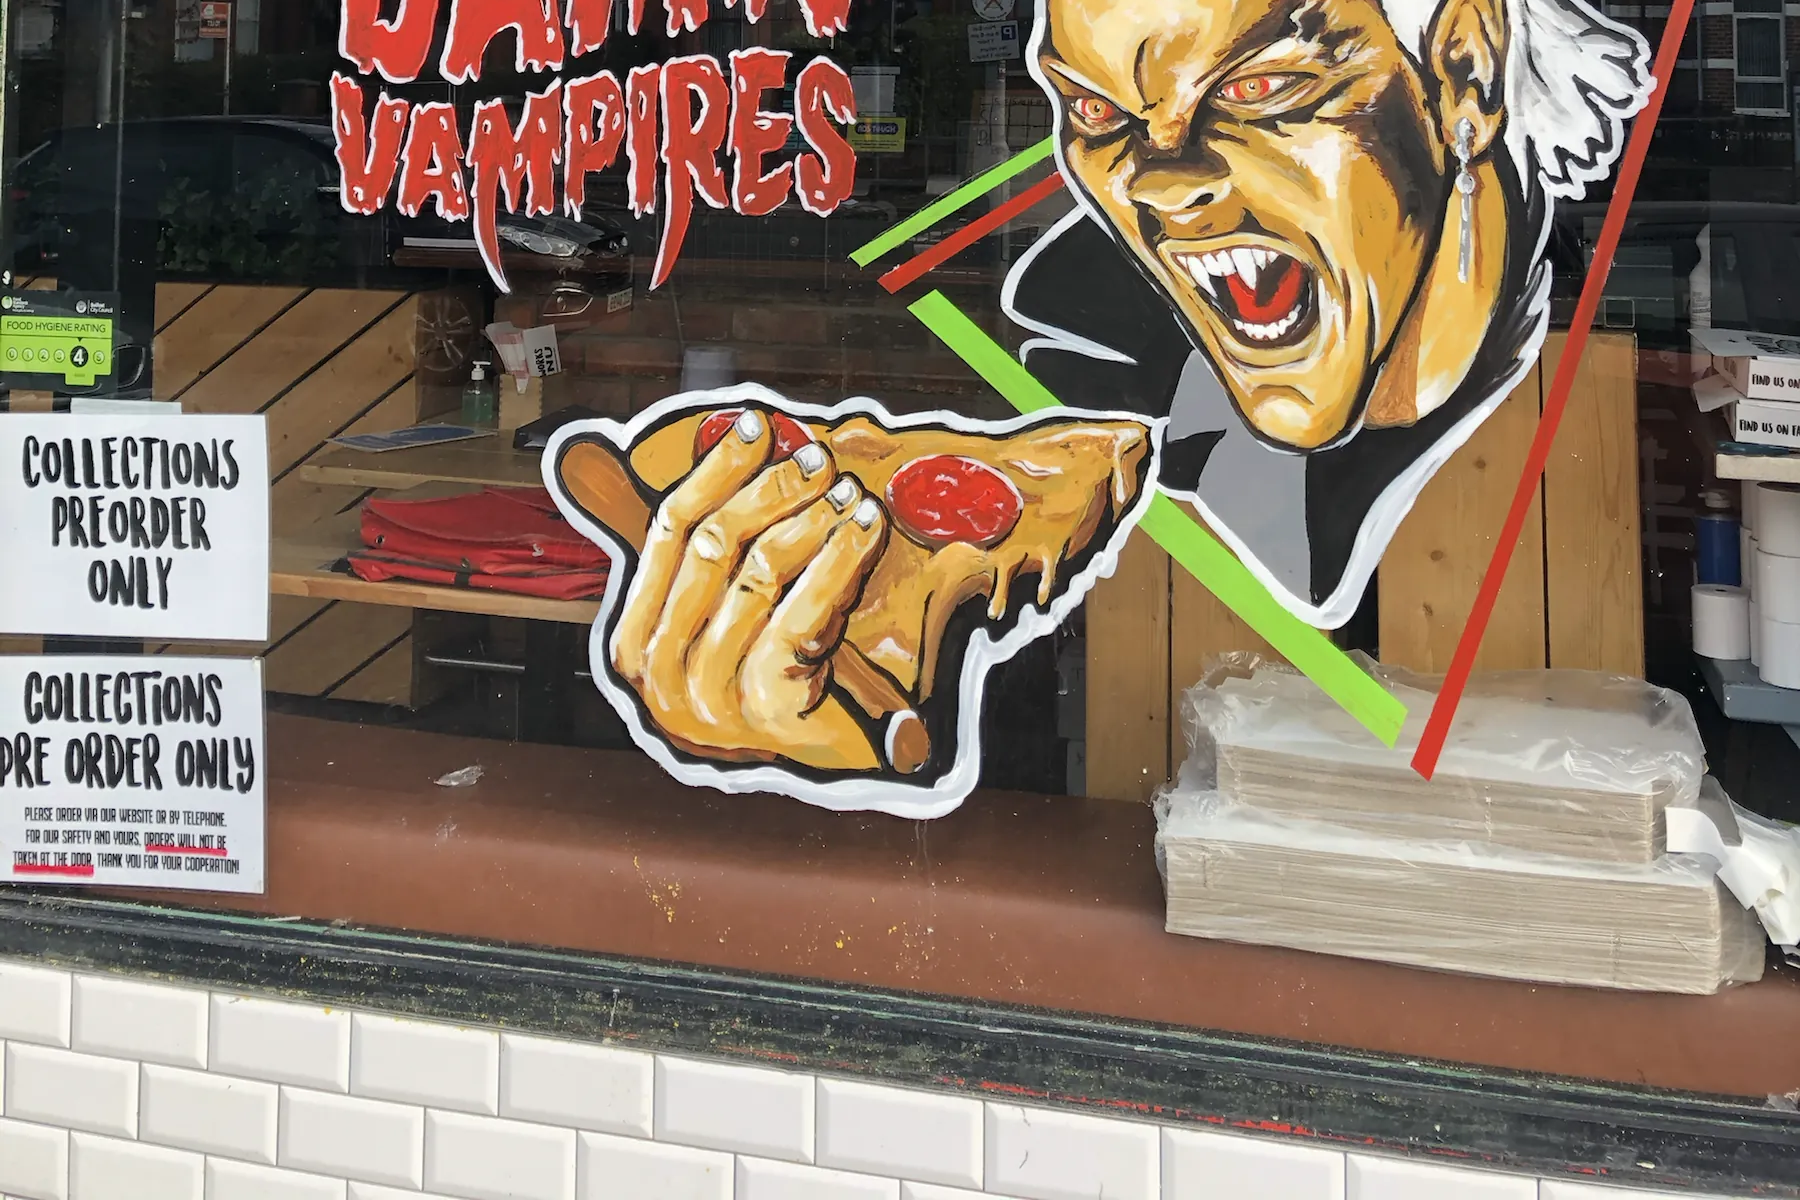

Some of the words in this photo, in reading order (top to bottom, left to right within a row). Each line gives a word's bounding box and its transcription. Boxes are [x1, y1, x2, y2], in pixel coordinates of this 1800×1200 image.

[329, 47, 858, 293] VAMPIRES
[7, 321, 33, 330] FOOD
[35, 322, 73, 332] HYGIENE
[74, 324, 106, 333] RATING
[73, 348, 84, 365] 4
[1752, 374, 1771, 386] FIND
[1773, 377, 1785, 388] US
[1788, 379, 1800, 389] ON
[1740, 419, 1759, 432] FIND
[1762, 422, 1773, 434] US
[1776, 424, 1789, 435] ON
[22, 435, 240, 491] COLLECTIONS
[52, 496, 211, 551] PREORDER
[87, 556, 173, 610] ONLY
[24, 671, 223, 727] COLLECTIONS
[64, 732, 163, 790] ORDER
[175, 736, 255, 794] ONLY
[24, 807, 53, 821] PLEASE
[56, 808, 82, 821] ORDER
[85, 808, 98, 822] VIA
[100, 808, 117, 822] OUR
[119, 809, 153, 823] WEBSITE
[156, 810, 167, 824] OR
[169, 810, 180, 824] BY
[182, 811, 227, 827] TELEPHONE.
[25, 829, 41, 843] FOR
[43, 829, 59, 843] OUR
[62, 830, 92, 844] SAFETY
[94, 831, 111, 844] AND
[144, 832, 175, 847] ORDERS
[177, 834, 197, 848] WILL
[199, 835, 214, 849] NOT
[217, 836, 227, 849] BE
[13, 851, 38, 865] TAKEN
[40, 852, 50, 865] AT
[53, 852, 68, 866] THE
[97, 853, 123, 868] THANK
[125, 854, 142, 869] YOU
[144, 855, 159, 869] FOR
[161, 856, 182, 870] YOUR
[184, 857, 240, 874] COOPERATION!
